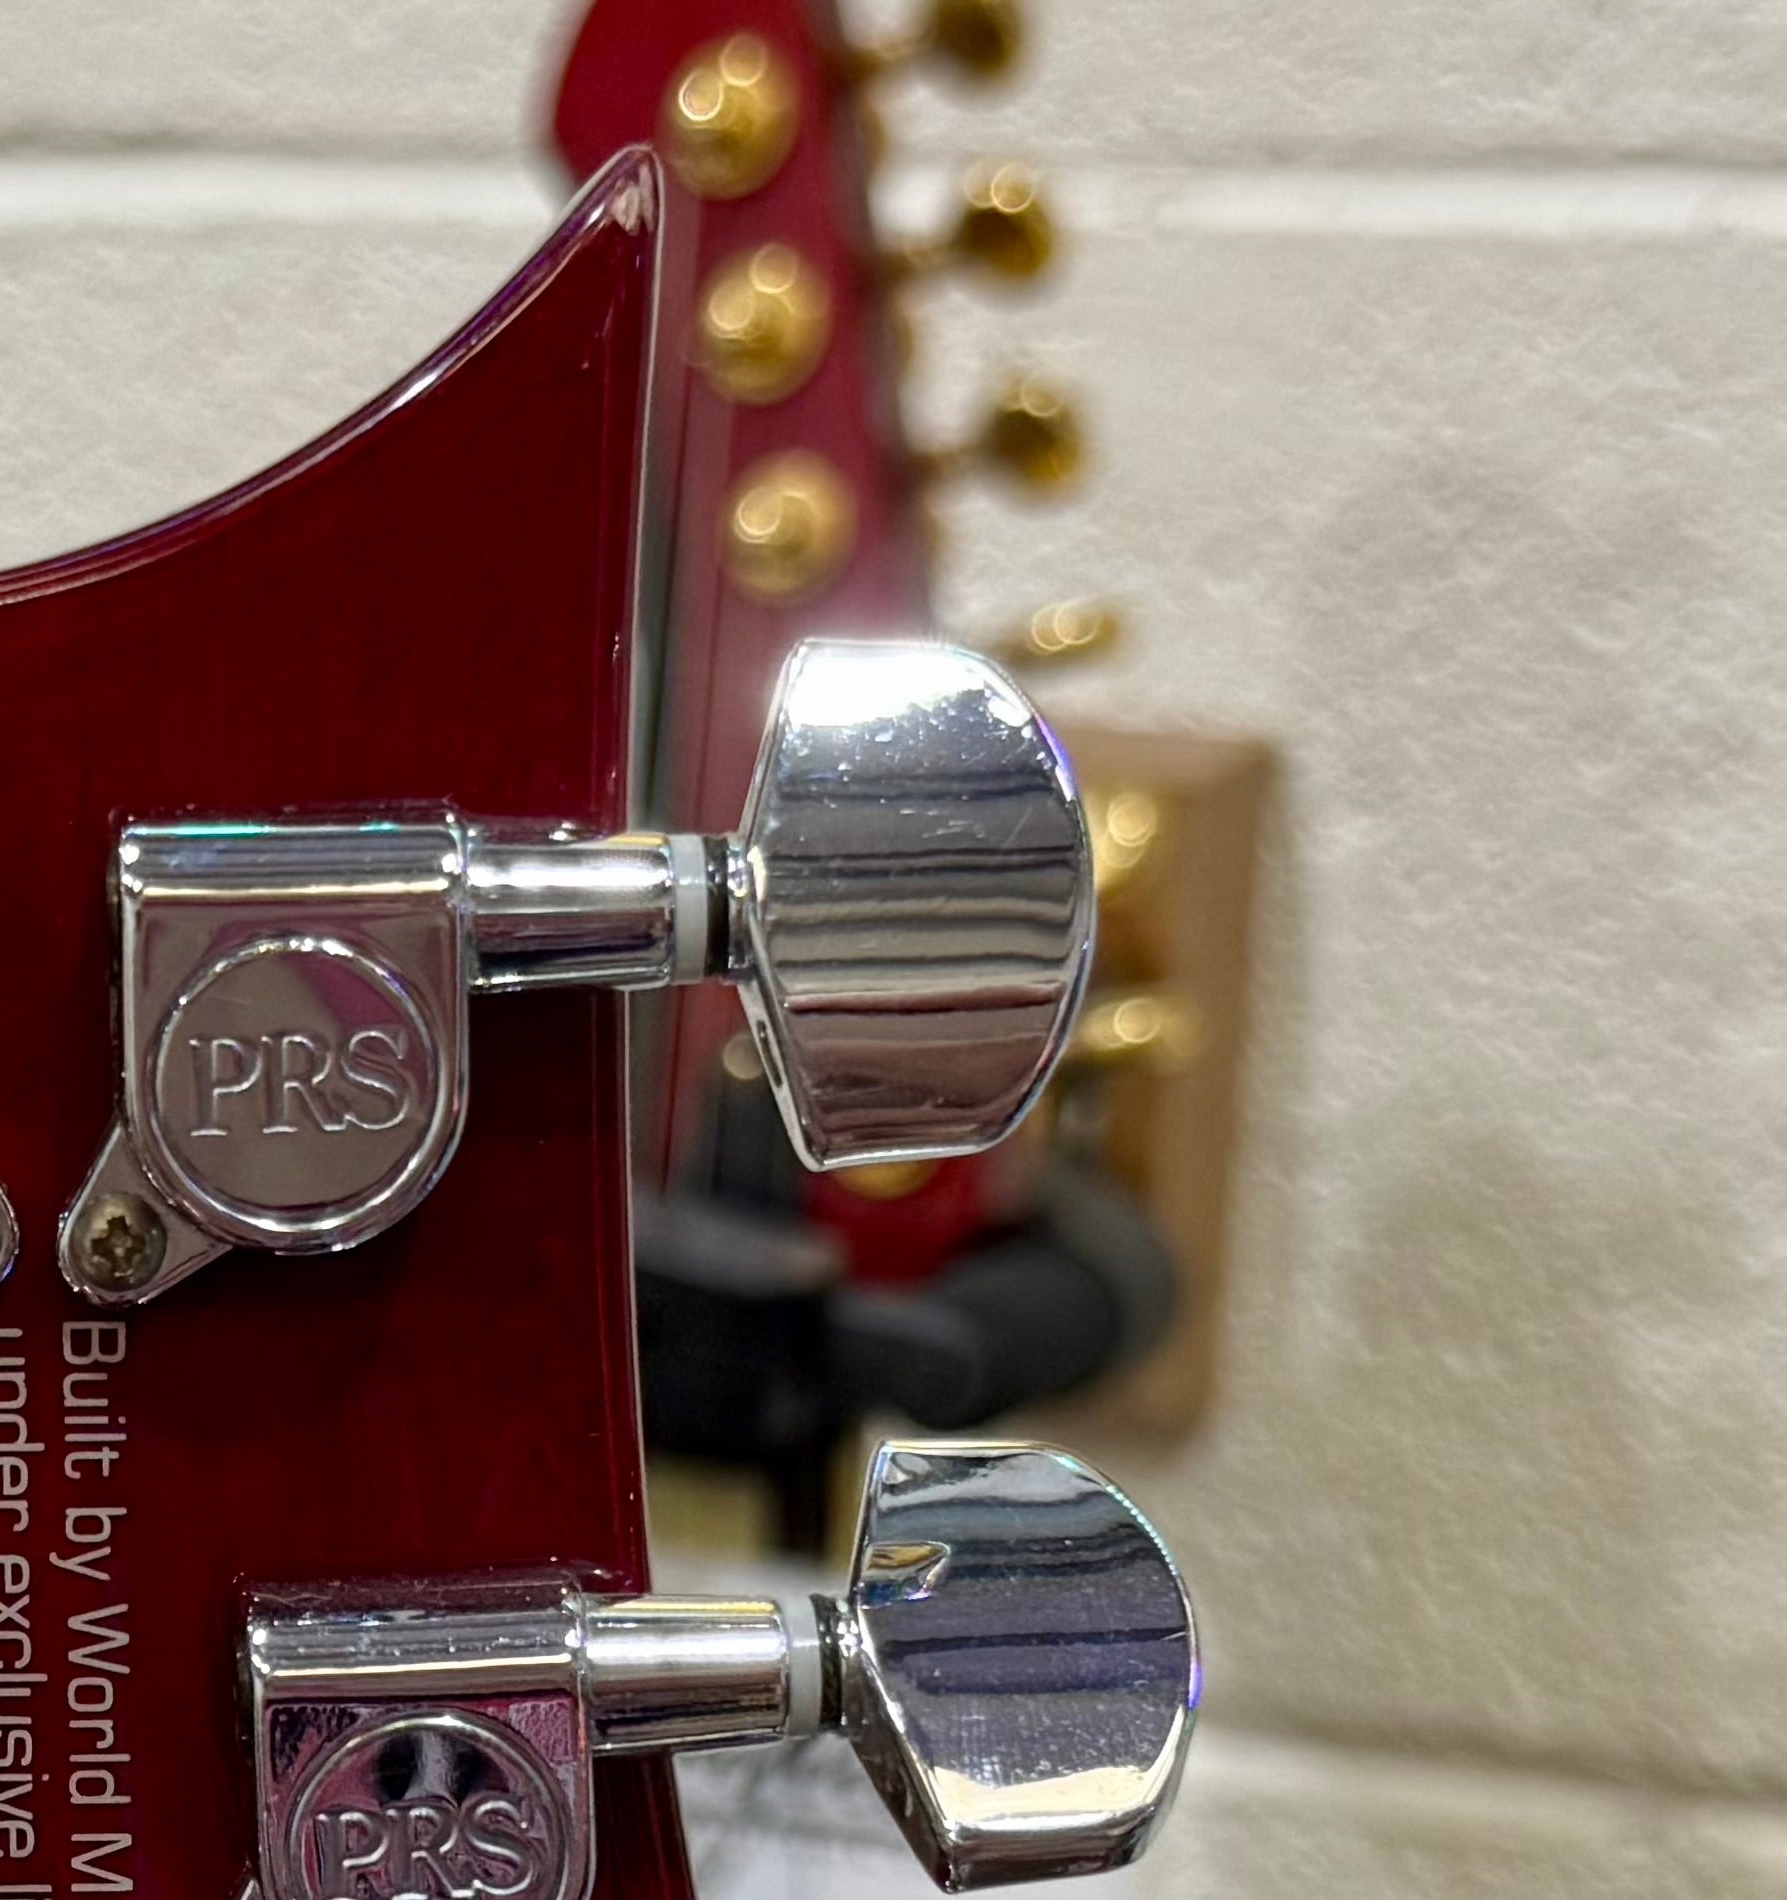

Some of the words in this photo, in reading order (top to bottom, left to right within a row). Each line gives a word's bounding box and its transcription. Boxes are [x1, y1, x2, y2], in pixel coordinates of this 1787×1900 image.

[187, 1028, 412, 1138] PRS
[63, 1322, 126, 1479] Built
[49, 1508, 127, 1580] by
[68, 1604, 131, 1804] World
